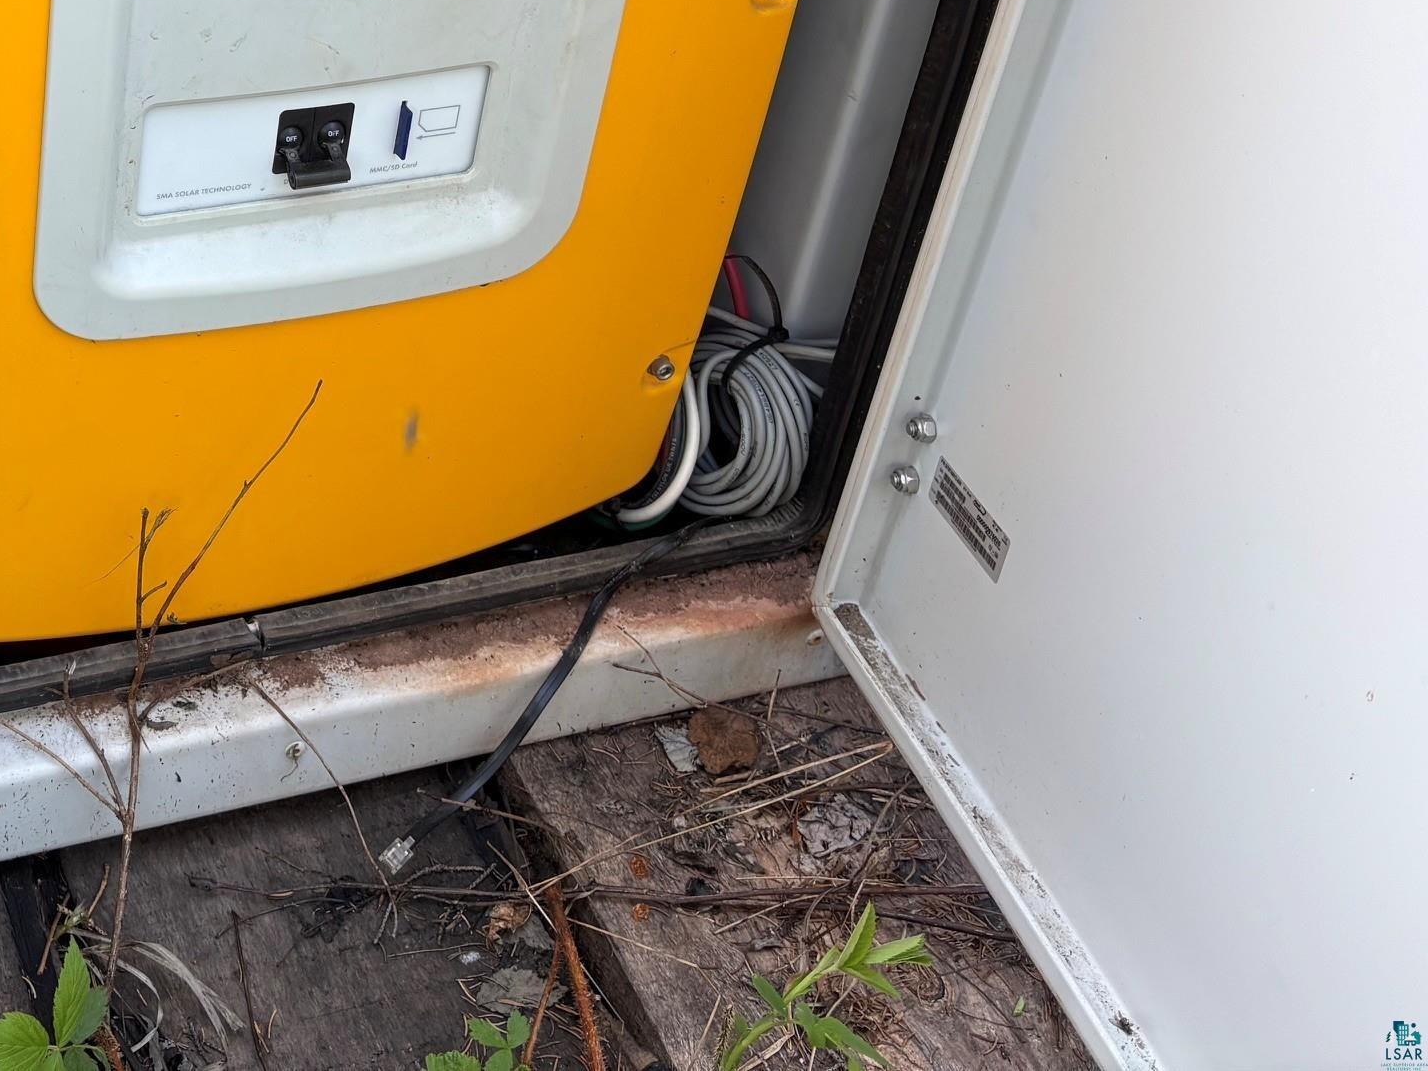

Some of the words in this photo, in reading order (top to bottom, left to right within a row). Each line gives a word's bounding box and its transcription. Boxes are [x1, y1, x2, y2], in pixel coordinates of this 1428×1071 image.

[369, 164, 400, 174] MMC/SD
[401, 161, 418, 170] Card
[156, 192, 173, 200] SMA
[174, 189, 200, 198] SOLAR
[201, 183, 252, 195] TECHNOLOGY
